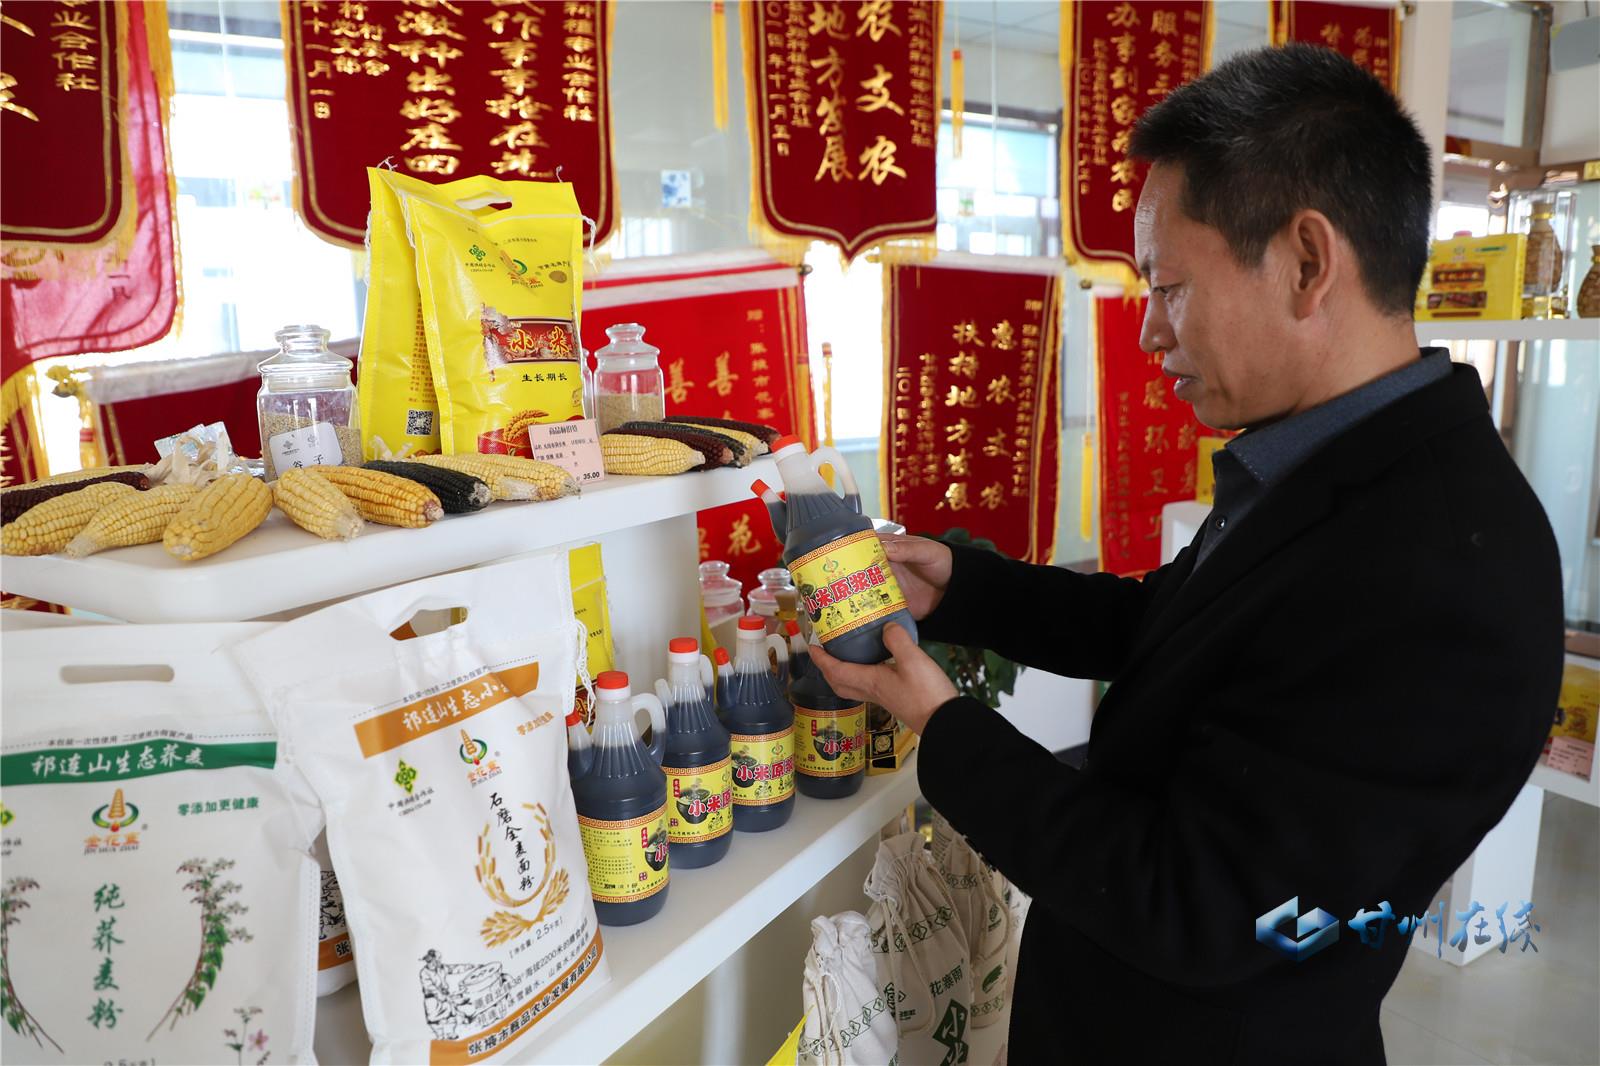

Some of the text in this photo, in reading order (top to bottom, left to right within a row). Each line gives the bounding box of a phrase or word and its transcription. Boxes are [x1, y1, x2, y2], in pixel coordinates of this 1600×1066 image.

[509, 325, 570, 358] 小米
[521, 372, 568, 383] 生长期长
[583, 471, 600, 480] 35.00
[804, 563, 888, 616] 小米原浆醋
[31, 743, 205, 778] 祁连山生态荞麦
[177, 796, 260, 817] 零添加更健康
[489, 791, 535, 892] 石磨全麦面粉
[87, 882, 126, 1030] 纯荞麦粉
